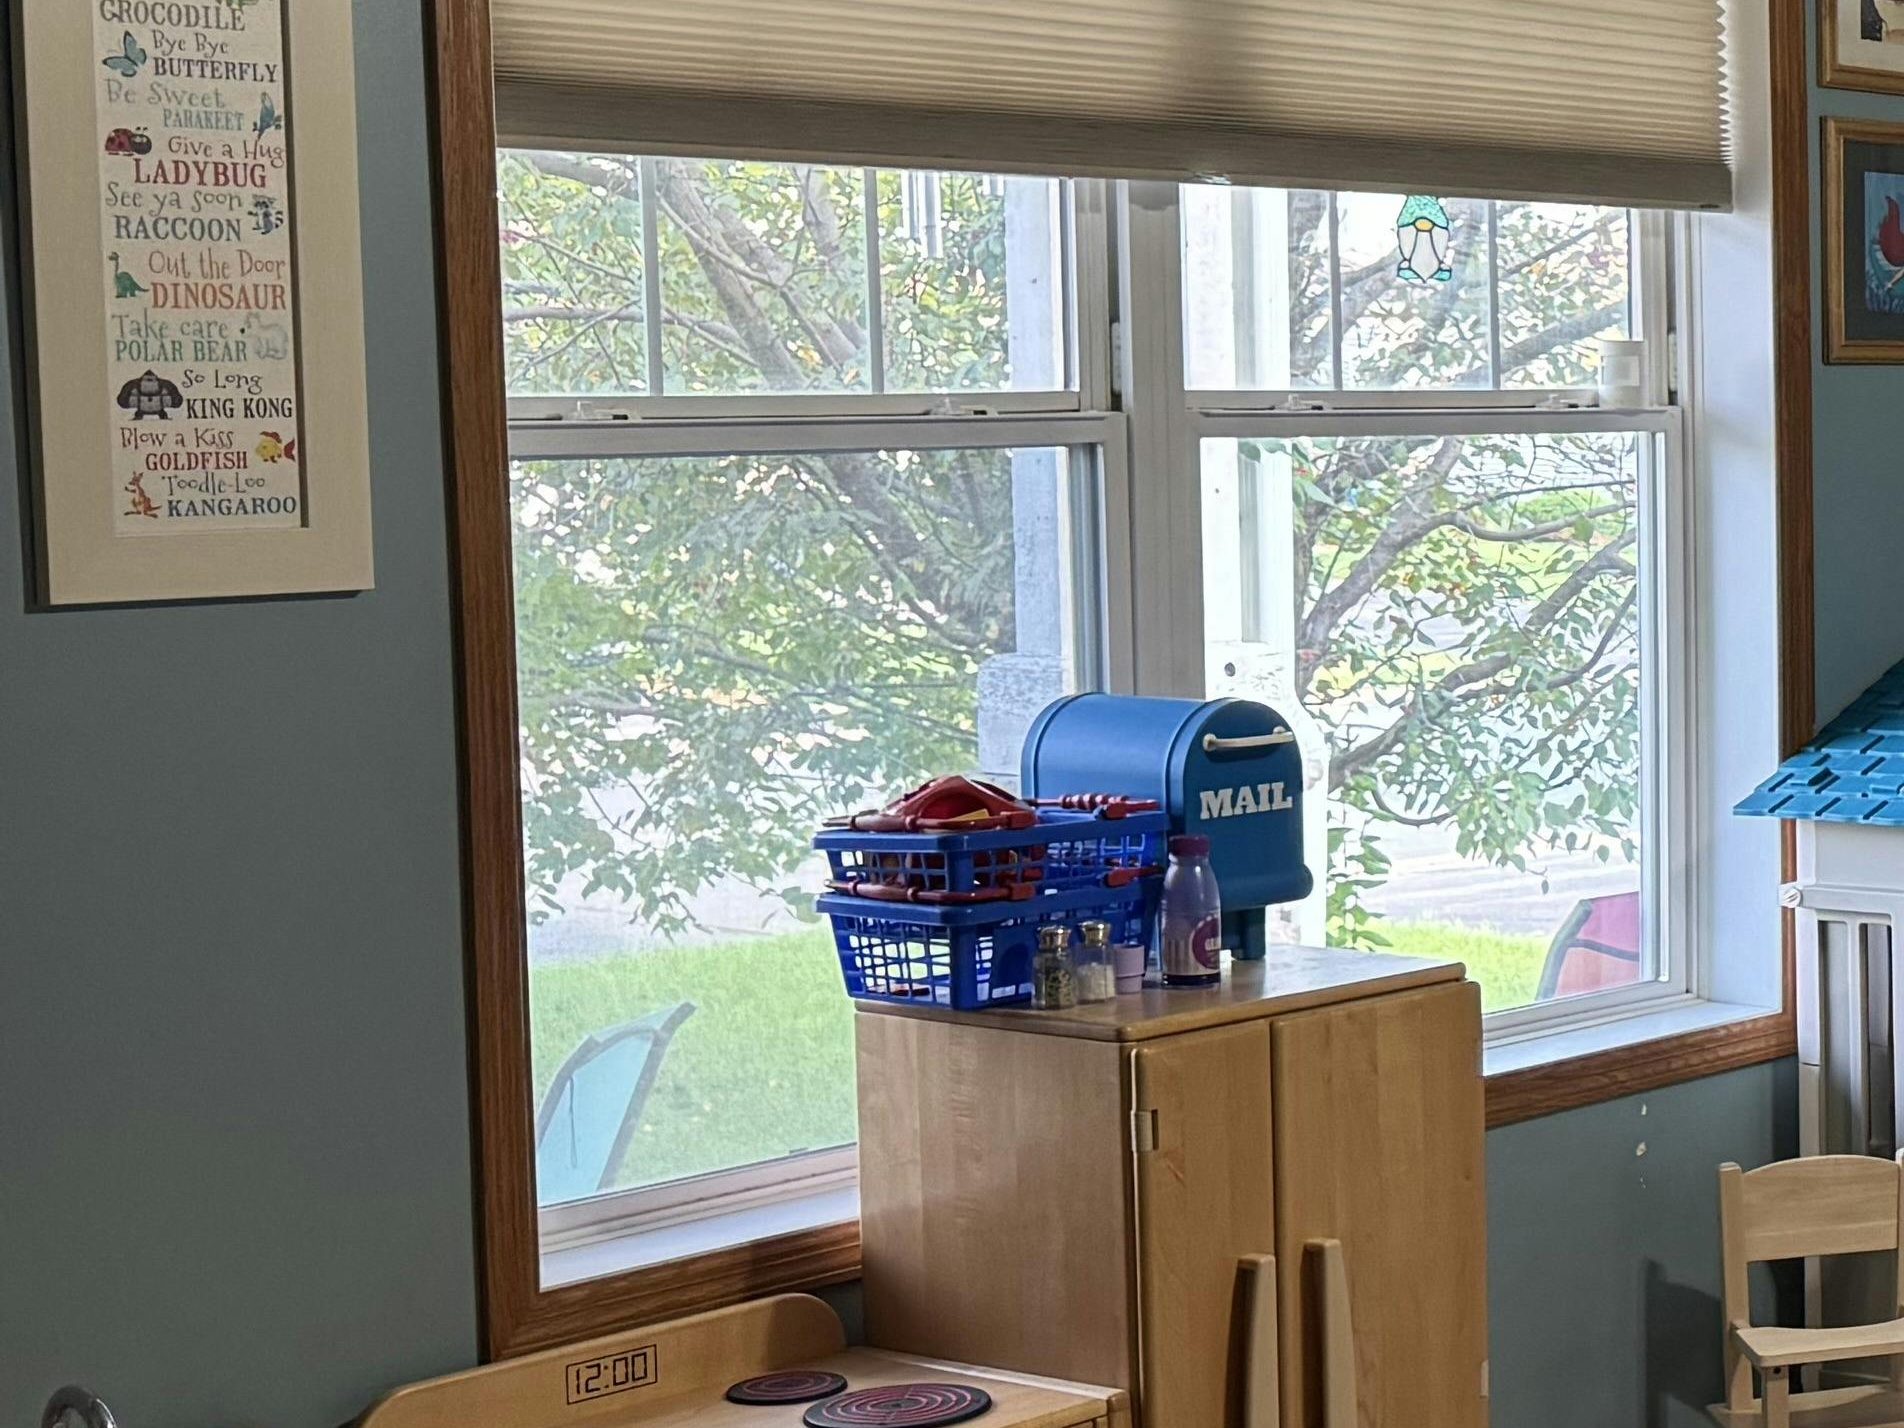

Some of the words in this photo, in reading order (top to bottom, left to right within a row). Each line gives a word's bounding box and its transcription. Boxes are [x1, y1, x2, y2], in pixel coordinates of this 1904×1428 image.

[151, 29, 186, 57] Bye
[194, 32, 229, 59] Bye
[153, 56, 278, 83] BUTTERFLY
[104, 78, 137, 105] Be
[147, 81, 227, 109] Sweet
[163, 108, 245, 132] PARAKEET
[168, 135, 213, 158] Give
[221, 144, 234, 159] a
[243, 139, 285, 169] Hug
[133, 158, 267, 188] LADYBUG
[105, 181, 143, 208] See
[149, 190, 182, 217] ya
[113, 214, 242, 243] RACCOON
[148, 249, 191, 280] Out
[199, 247, 230, 280] the
[235, 248, 286, 281] Door
[151, 281, 287, 311] DINOSAUR
[111, 307, 170, 341] Take
[180, 320, 229, 340] care
[115, 339, 184, 364] POLAR
[193, 339, 248, 364] BEAR
[181, 369, 206, 390] So
[214, 369, 264, 397] Long
[186, 397, 235, 421] KING
[243, 397, 293, 421] KONG
[175, 433, 186, 449] a
[194, 427, 235, 450] Kiss
[145, 450, 249, 471] GOLDFISH
[167, 495, 297, 518] KANGAROO
[1199, 781, 1294, 820] MAIL
[576, 1352, 648, 1395] 12:00
